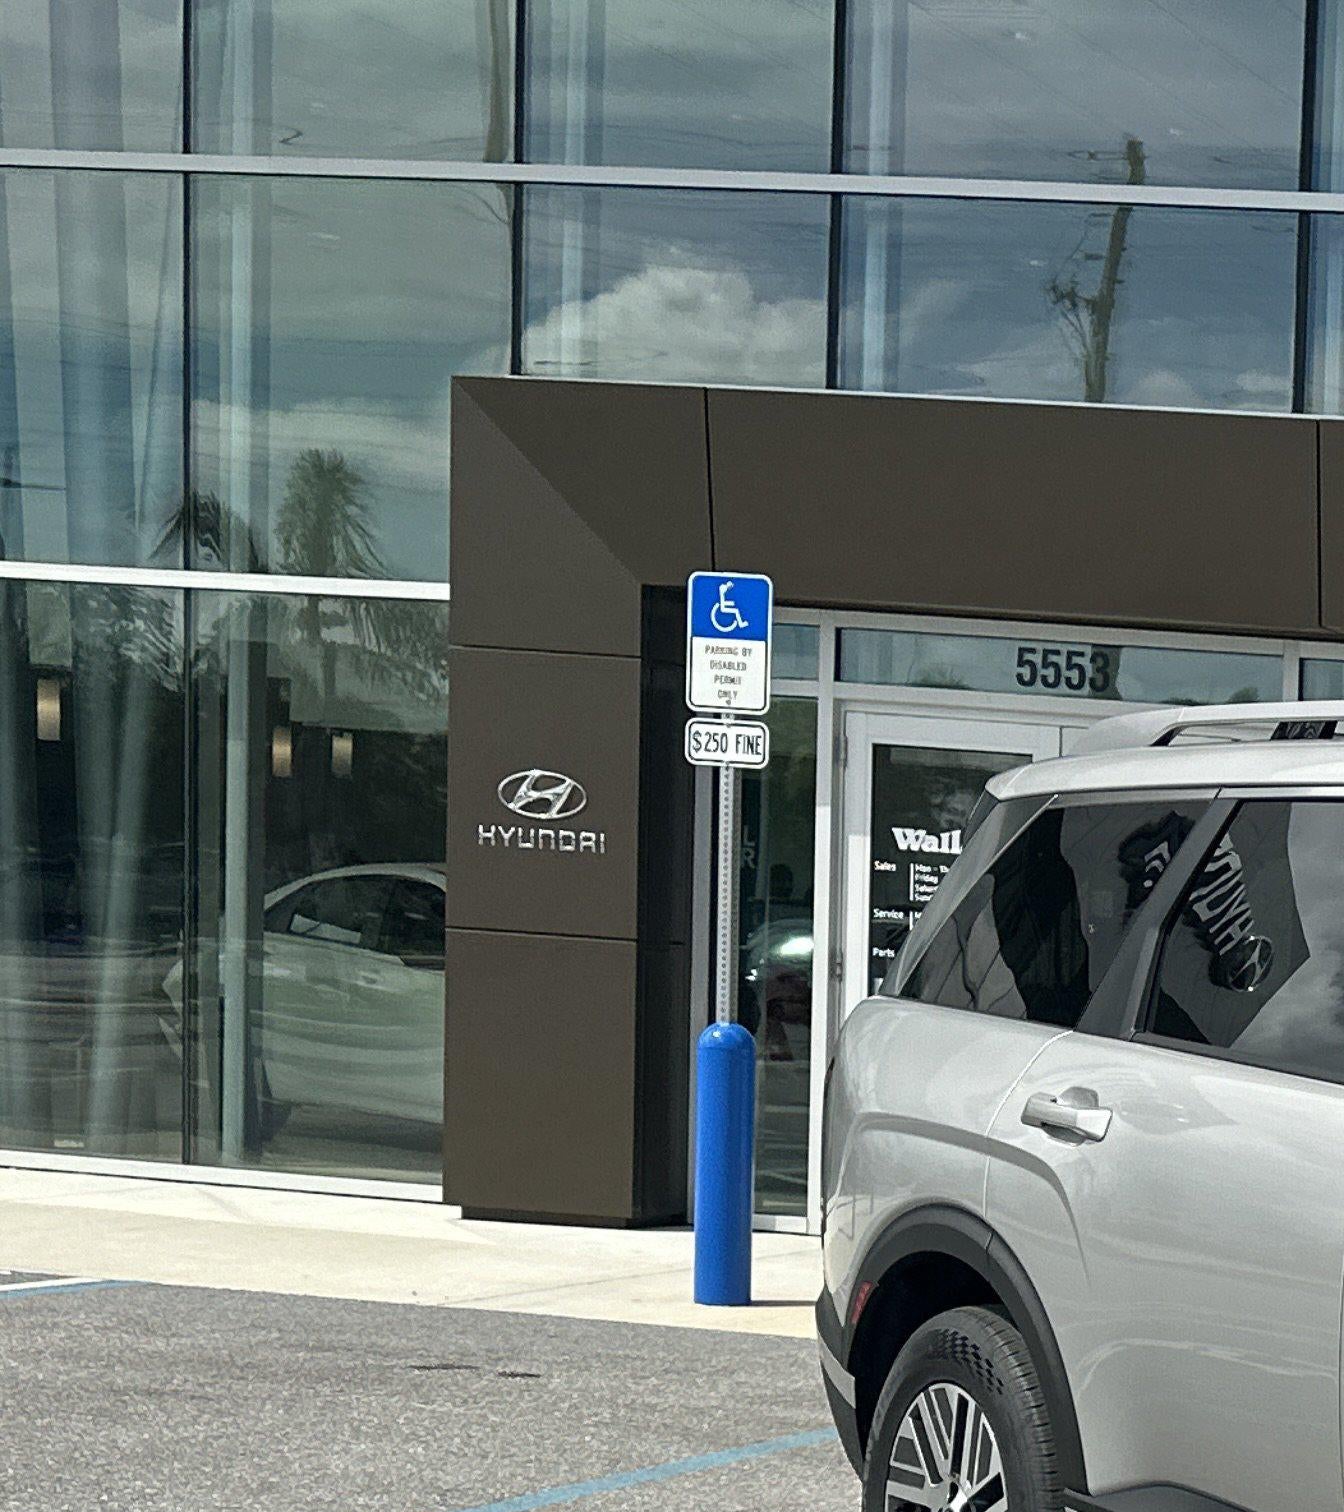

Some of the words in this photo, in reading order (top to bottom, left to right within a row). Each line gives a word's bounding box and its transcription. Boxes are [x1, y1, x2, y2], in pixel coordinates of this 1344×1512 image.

[704, 644, 739, 656] PARKING
[742, 647, 752, 657] BY
[709, 660, 747, 671] DISABLED
[1016, 647, 1110, 693] 5553
[713, 674, 742, 685] PERMIT
[692, 730, 728, 754] $250
[736, 733, 762, 756] FINE
[478, 824, 605, 854] HYUNDAI
[891, 827, 963, 855] Wall
[873, 860, 897, 872] Sales
[873, 908, 905, 920] Service
